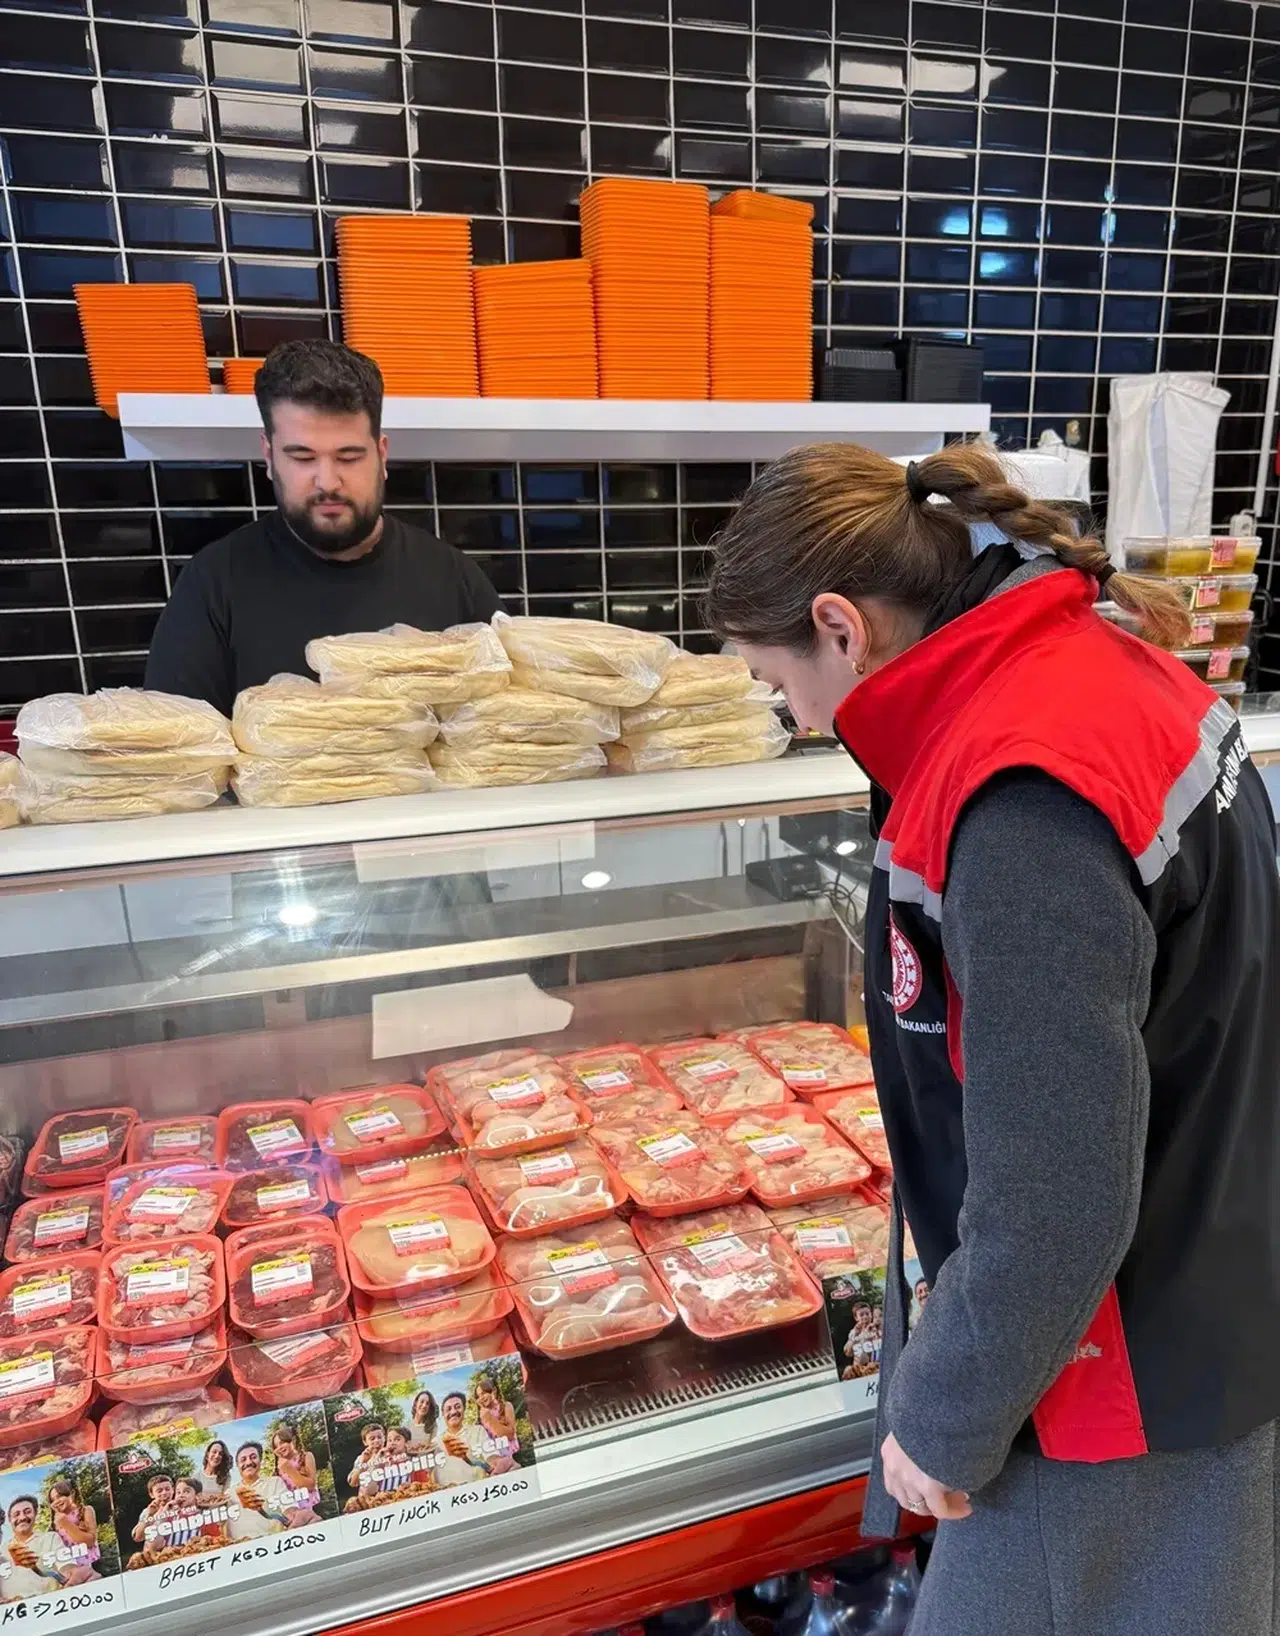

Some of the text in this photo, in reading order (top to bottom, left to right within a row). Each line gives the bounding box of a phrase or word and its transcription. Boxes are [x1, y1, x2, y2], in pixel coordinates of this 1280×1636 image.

[359, 1514, 395, 1537] BUT
[482, 1480, 528, 1503] 150.00
[159, 1556, 221, 1589] BAGET
[53, 1592, 114, 1616] 200.00
